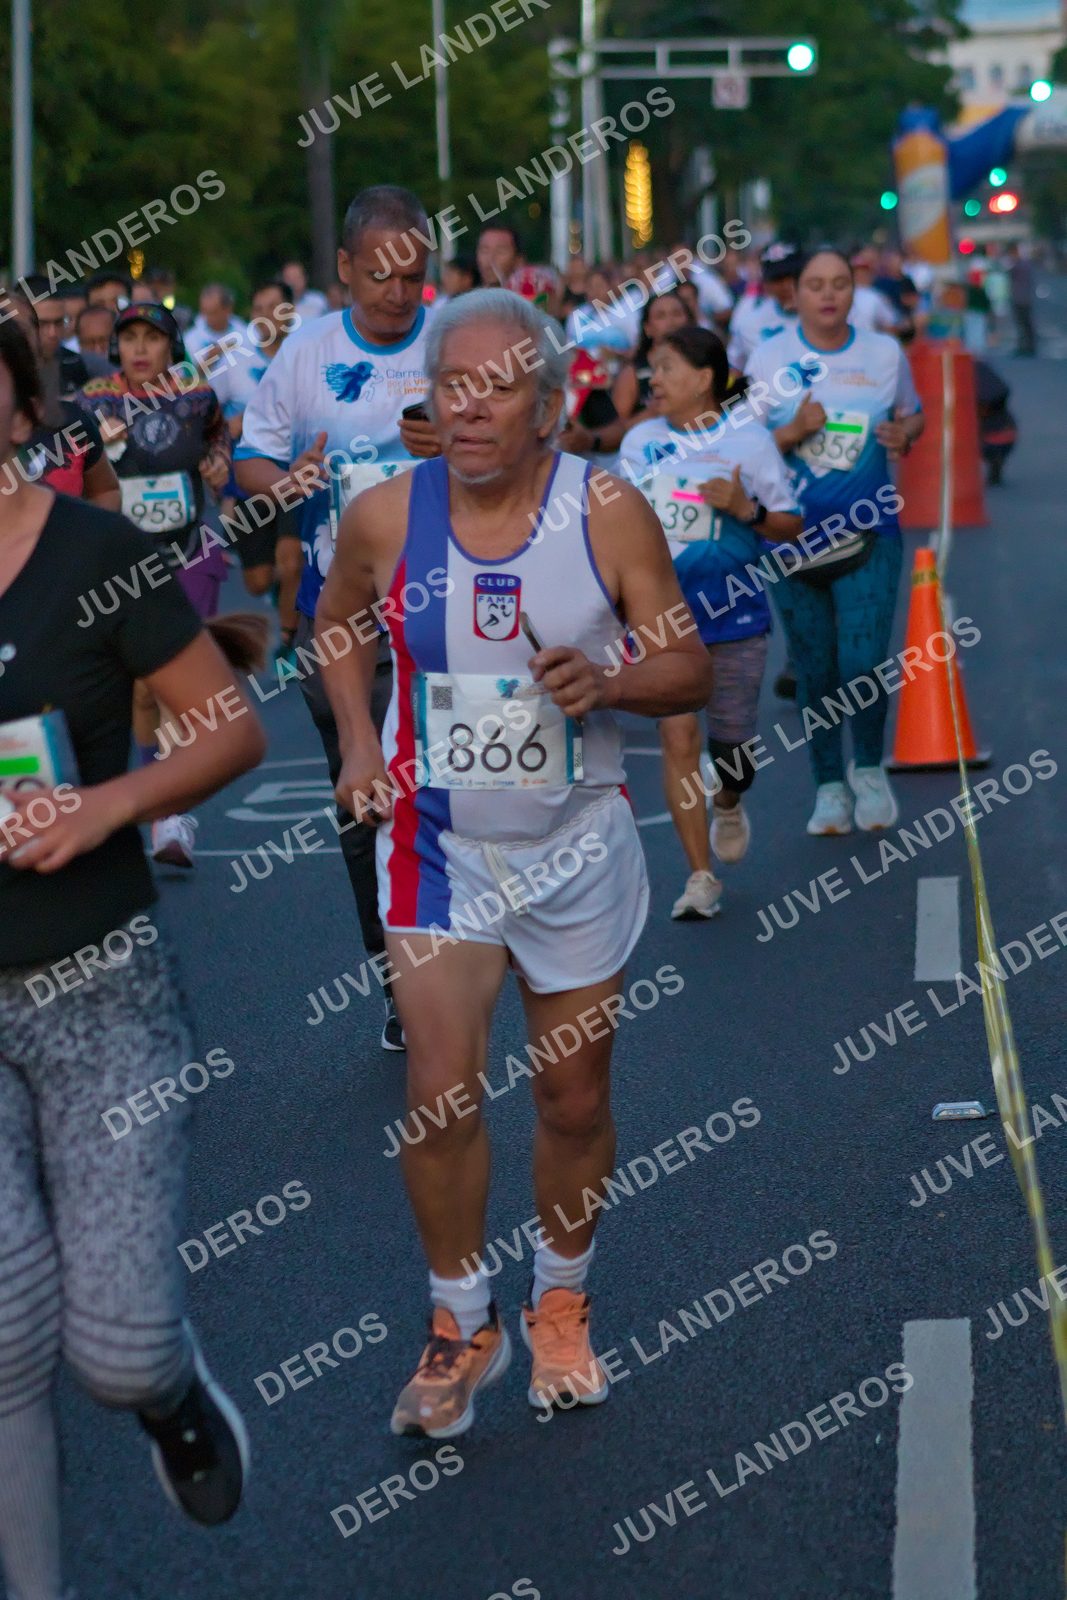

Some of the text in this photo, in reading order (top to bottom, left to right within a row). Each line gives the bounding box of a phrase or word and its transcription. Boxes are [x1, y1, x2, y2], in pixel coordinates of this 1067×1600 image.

[131, 500, 184, 524] 953
[652, 499, 698, 532] 39
[477, 577, 516, 587] CLUB
[478, 595, 514, 604] FAMA
[447, 722, 547, 773] 866
